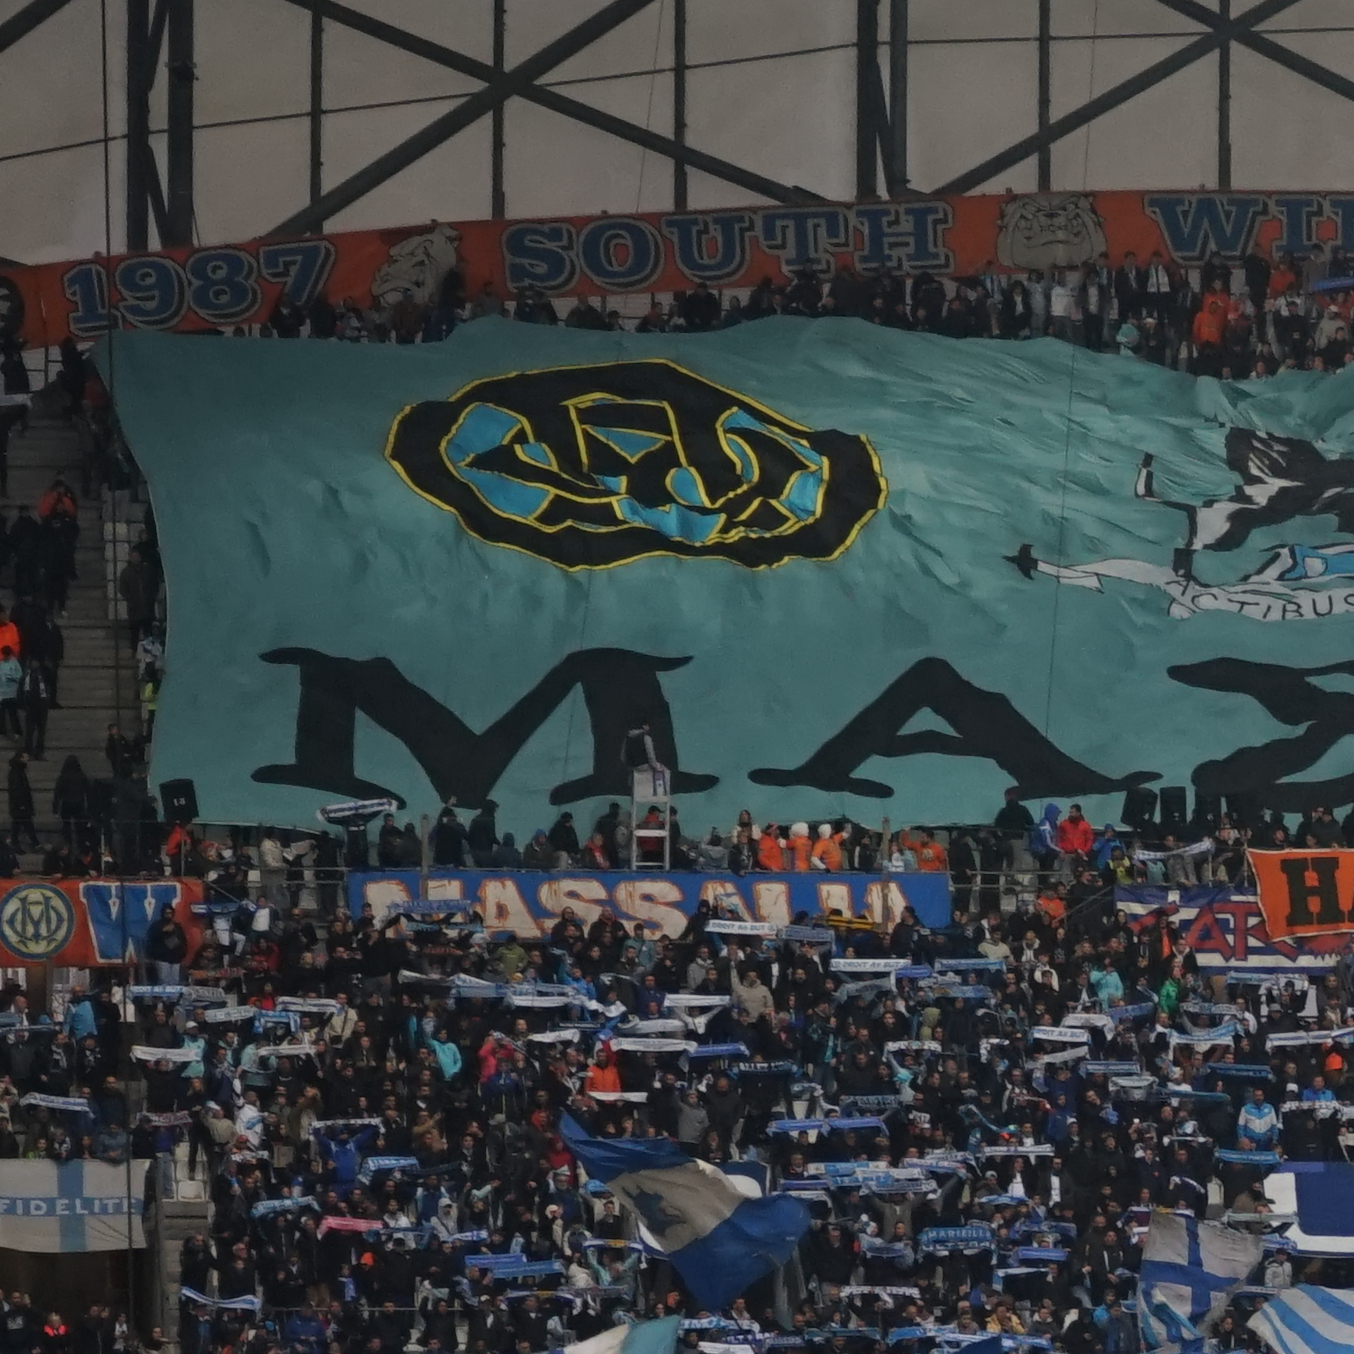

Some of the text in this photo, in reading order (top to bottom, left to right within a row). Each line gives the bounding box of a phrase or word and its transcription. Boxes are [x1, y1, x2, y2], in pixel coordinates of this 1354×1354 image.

[62, 238, 337, 338] 1987
[502, 203, 956, 296] SOUTH
[363, 877, 909, 940] MASSALIA
